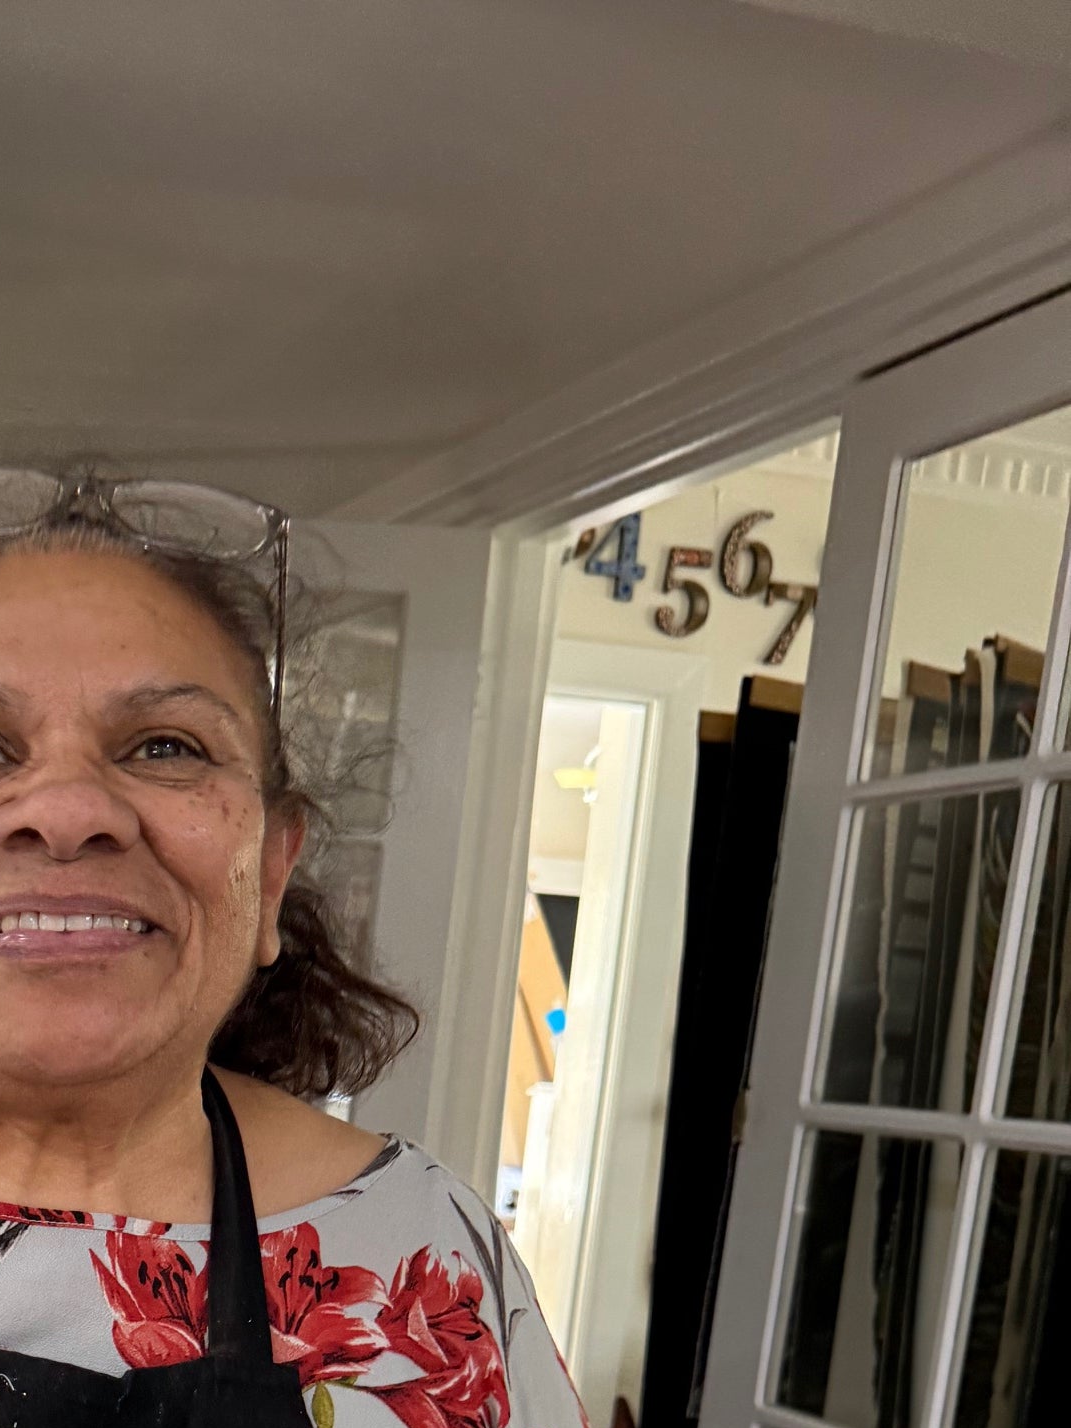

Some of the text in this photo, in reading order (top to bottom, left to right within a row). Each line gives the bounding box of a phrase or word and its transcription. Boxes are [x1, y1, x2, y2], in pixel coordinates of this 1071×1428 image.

[584, 510, 646, 602] 4
[654, 547, 714, 637] 5
[720, 510, 774, 598] 6
[763, 582, 818, 666] 7
